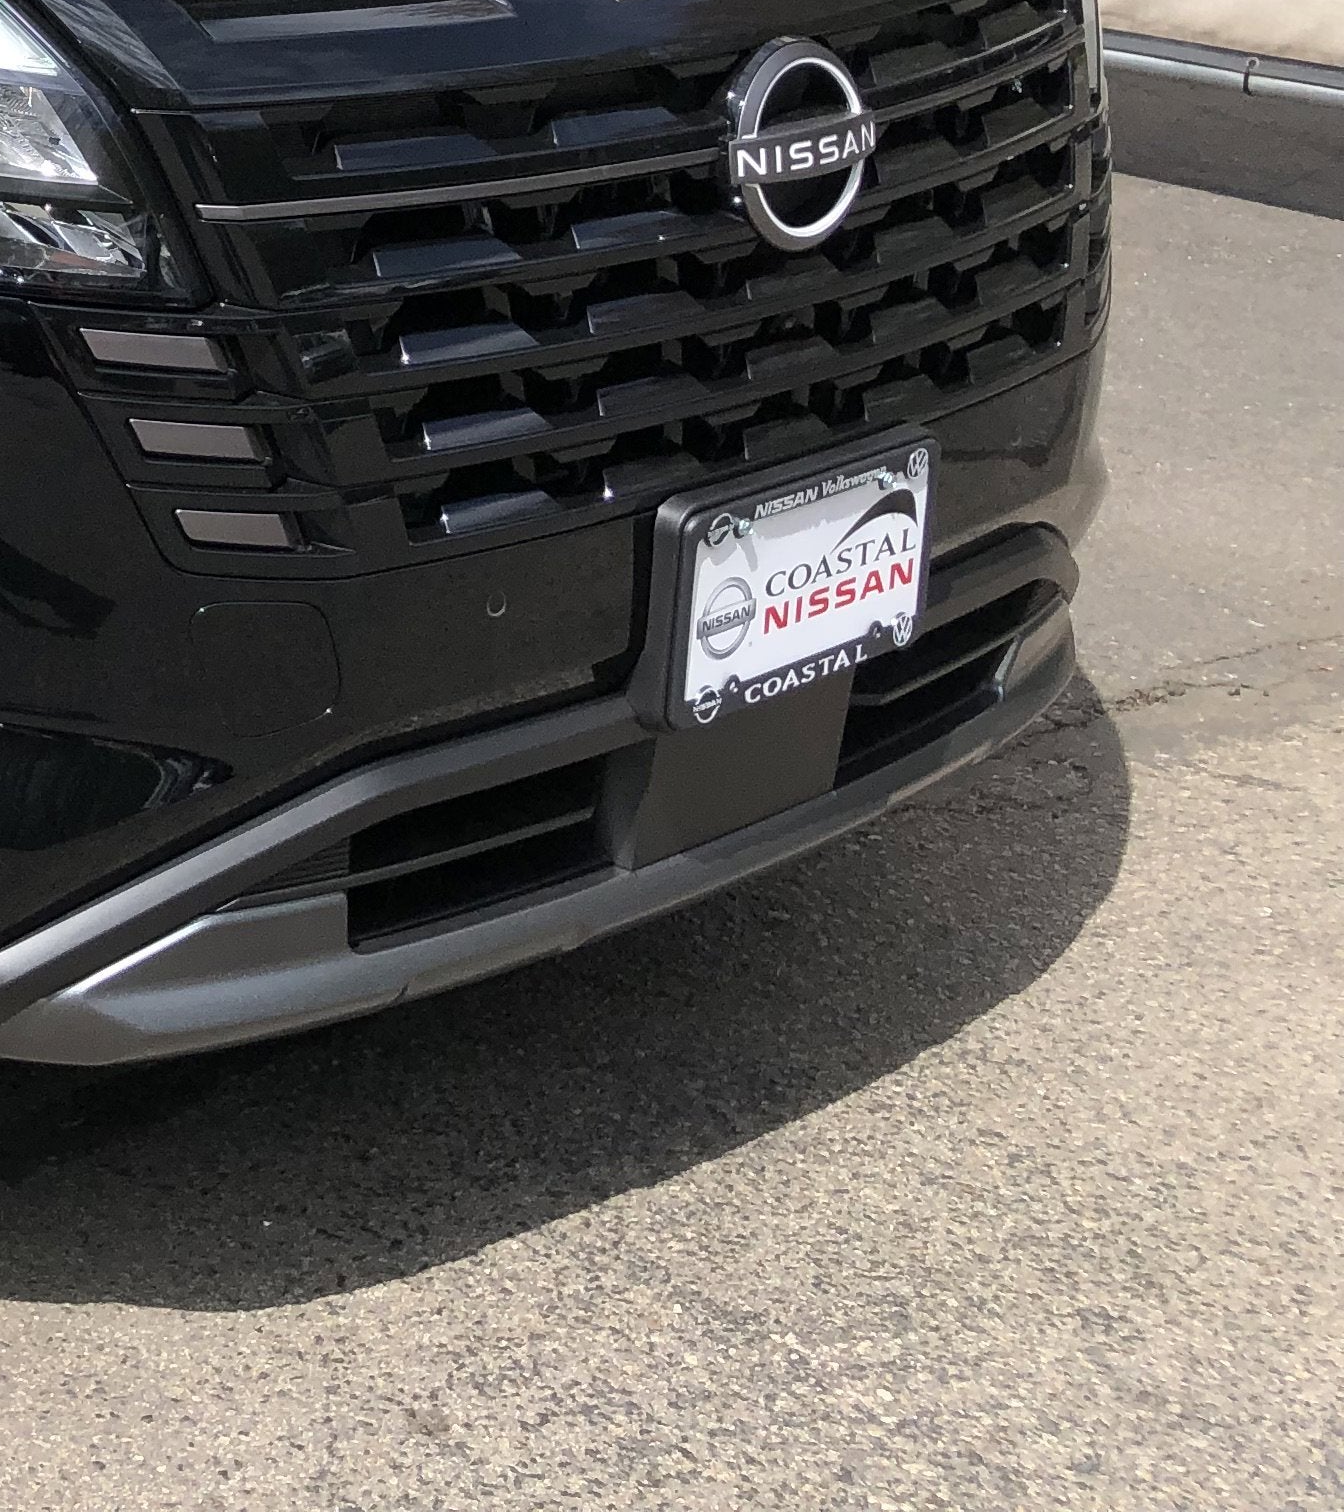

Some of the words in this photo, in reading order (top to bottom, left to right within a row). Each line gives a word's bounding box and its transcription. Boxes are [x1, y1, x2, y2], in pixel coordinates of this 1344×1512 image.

[736, 121, 876, 178] NISSAN
[754, 486, 819, 520] NISSAN
[765, 527, 917, 598] COASTAL
[702, 604, 752, 633] NISSAN
[763, 557, 915, 635] NISSAN
[744, 643, 868, 704] COASTAL
